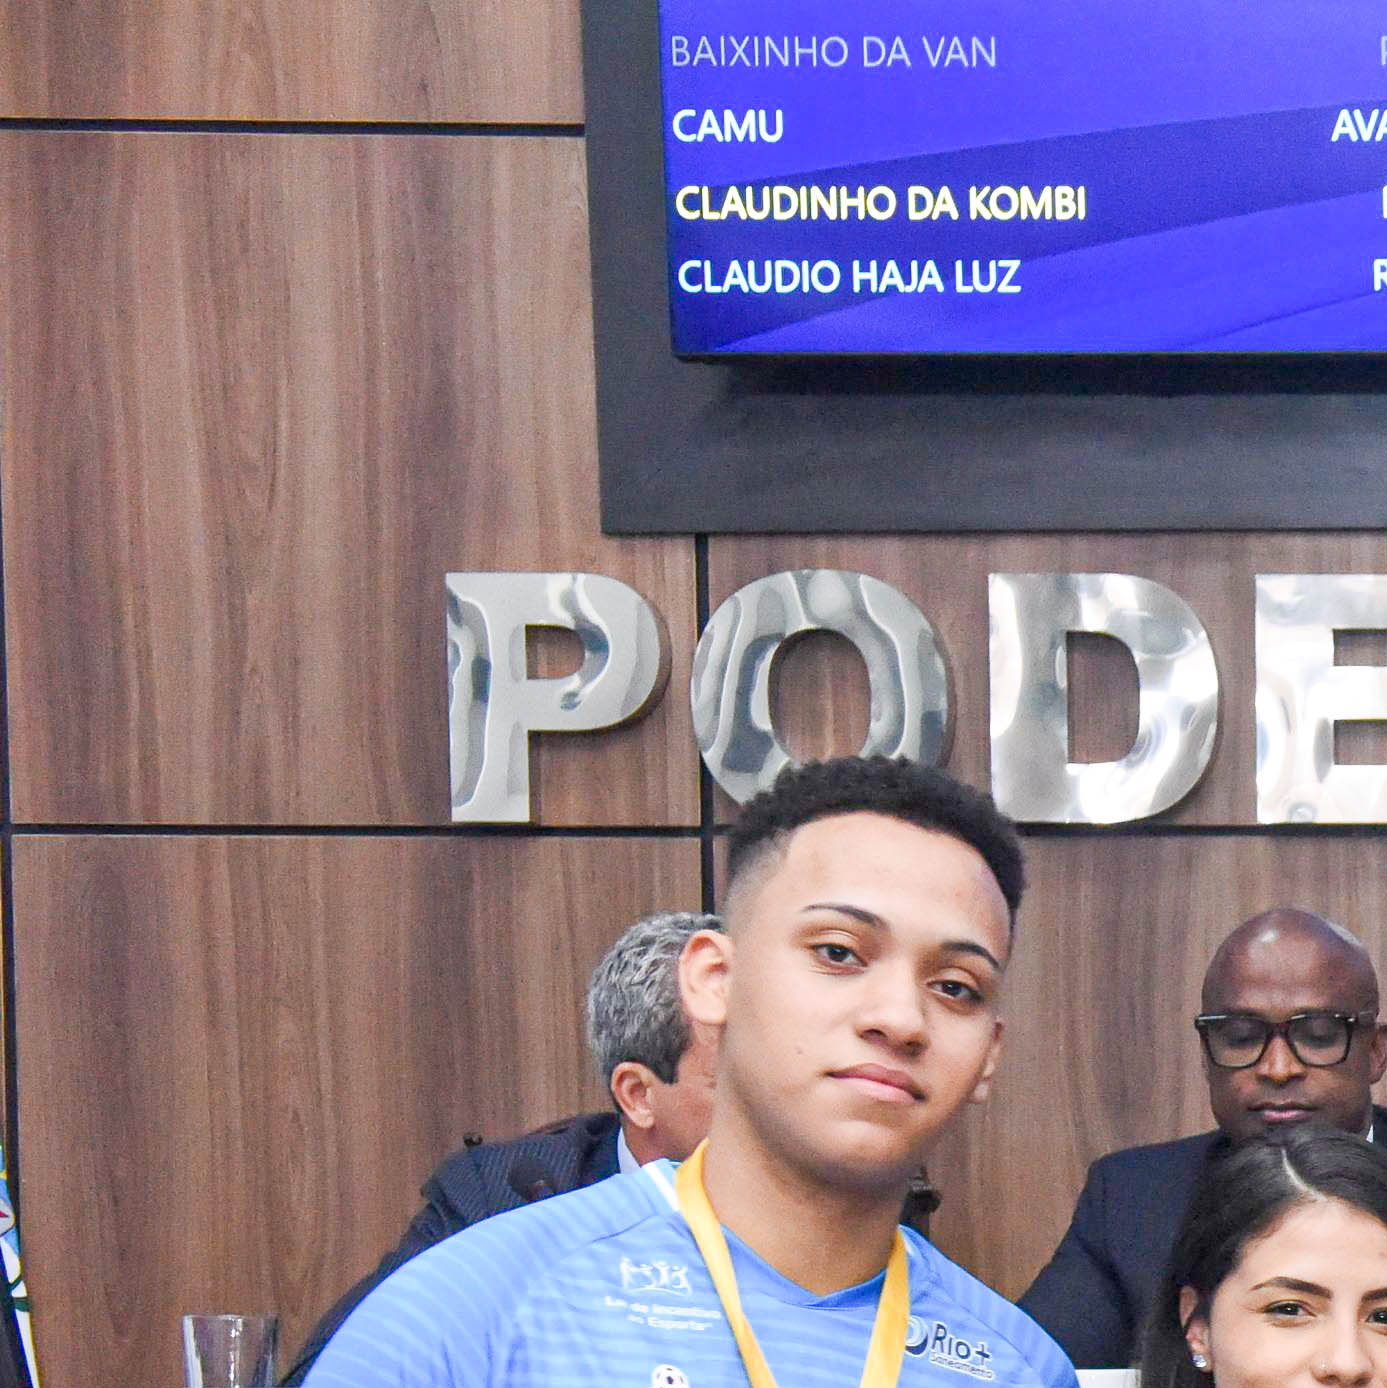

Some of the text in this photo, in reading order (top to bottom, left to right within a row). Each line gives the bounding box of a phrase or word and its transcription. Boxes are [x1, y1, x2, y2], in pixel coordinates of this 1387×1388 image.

[671, 35, 996, 68] BAIXINHO DA VAN
[672, 108, 784, 143] CAMU
[675, 185, 1086, 221] CLAUDINHO DA KOMBI
[678, 259, 1022, 294] CLAUDIO HAJA LUZ
